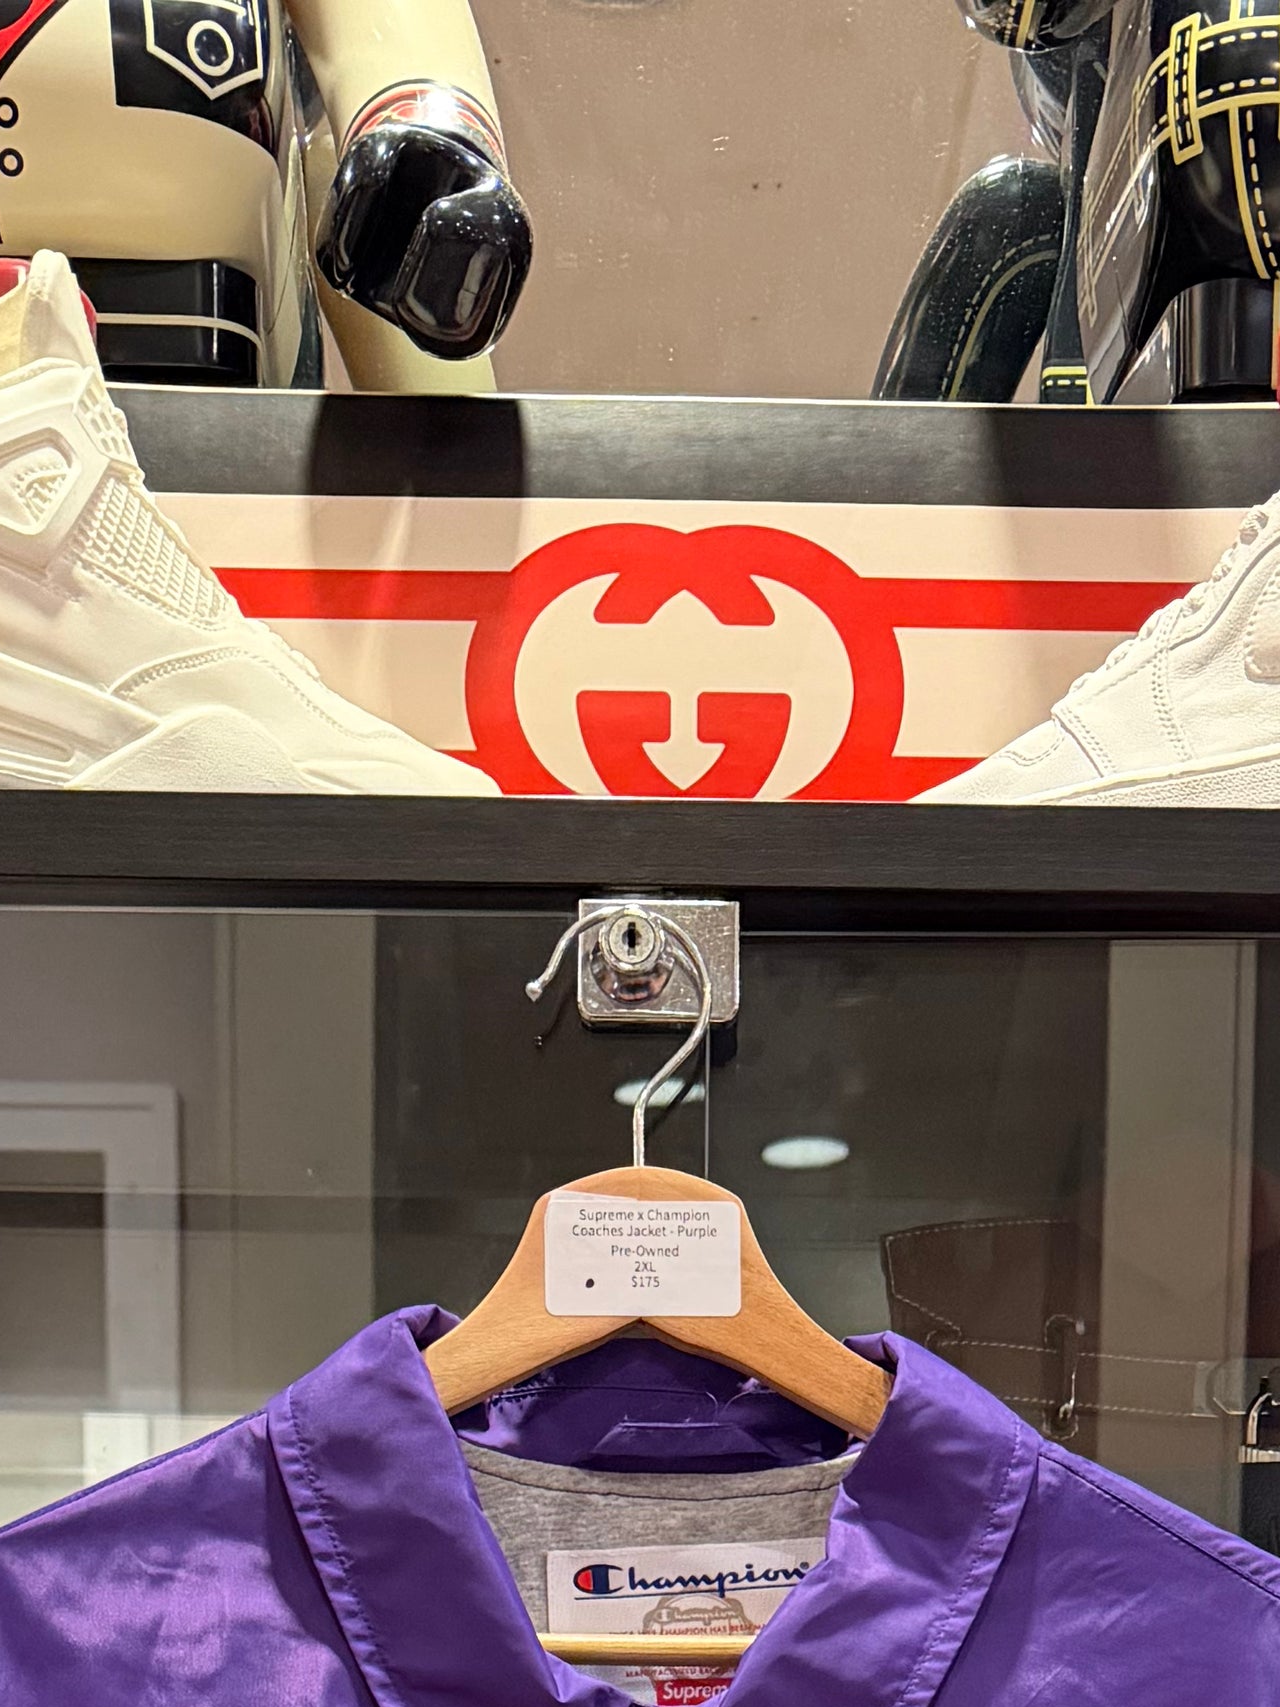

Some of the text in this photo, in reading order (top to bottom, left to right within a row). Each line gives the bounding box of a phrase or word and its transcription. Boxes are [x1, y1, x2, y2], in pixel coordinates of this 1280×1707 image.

[579, 1209, 710, 1223] Supreme x Champion
[572, 1225, 623, 1237] Coaches
[627, 1225, 666, 1237] Jacket
[677, 1225, 718, 1239] Purple
[611, 1245, 680, 1257] Pre-Owned
[634, 1261, 657, 1272] 2XL
[631, 1276, 660, 1288] $175
[662, 1681, 729, 1704] Suprem
